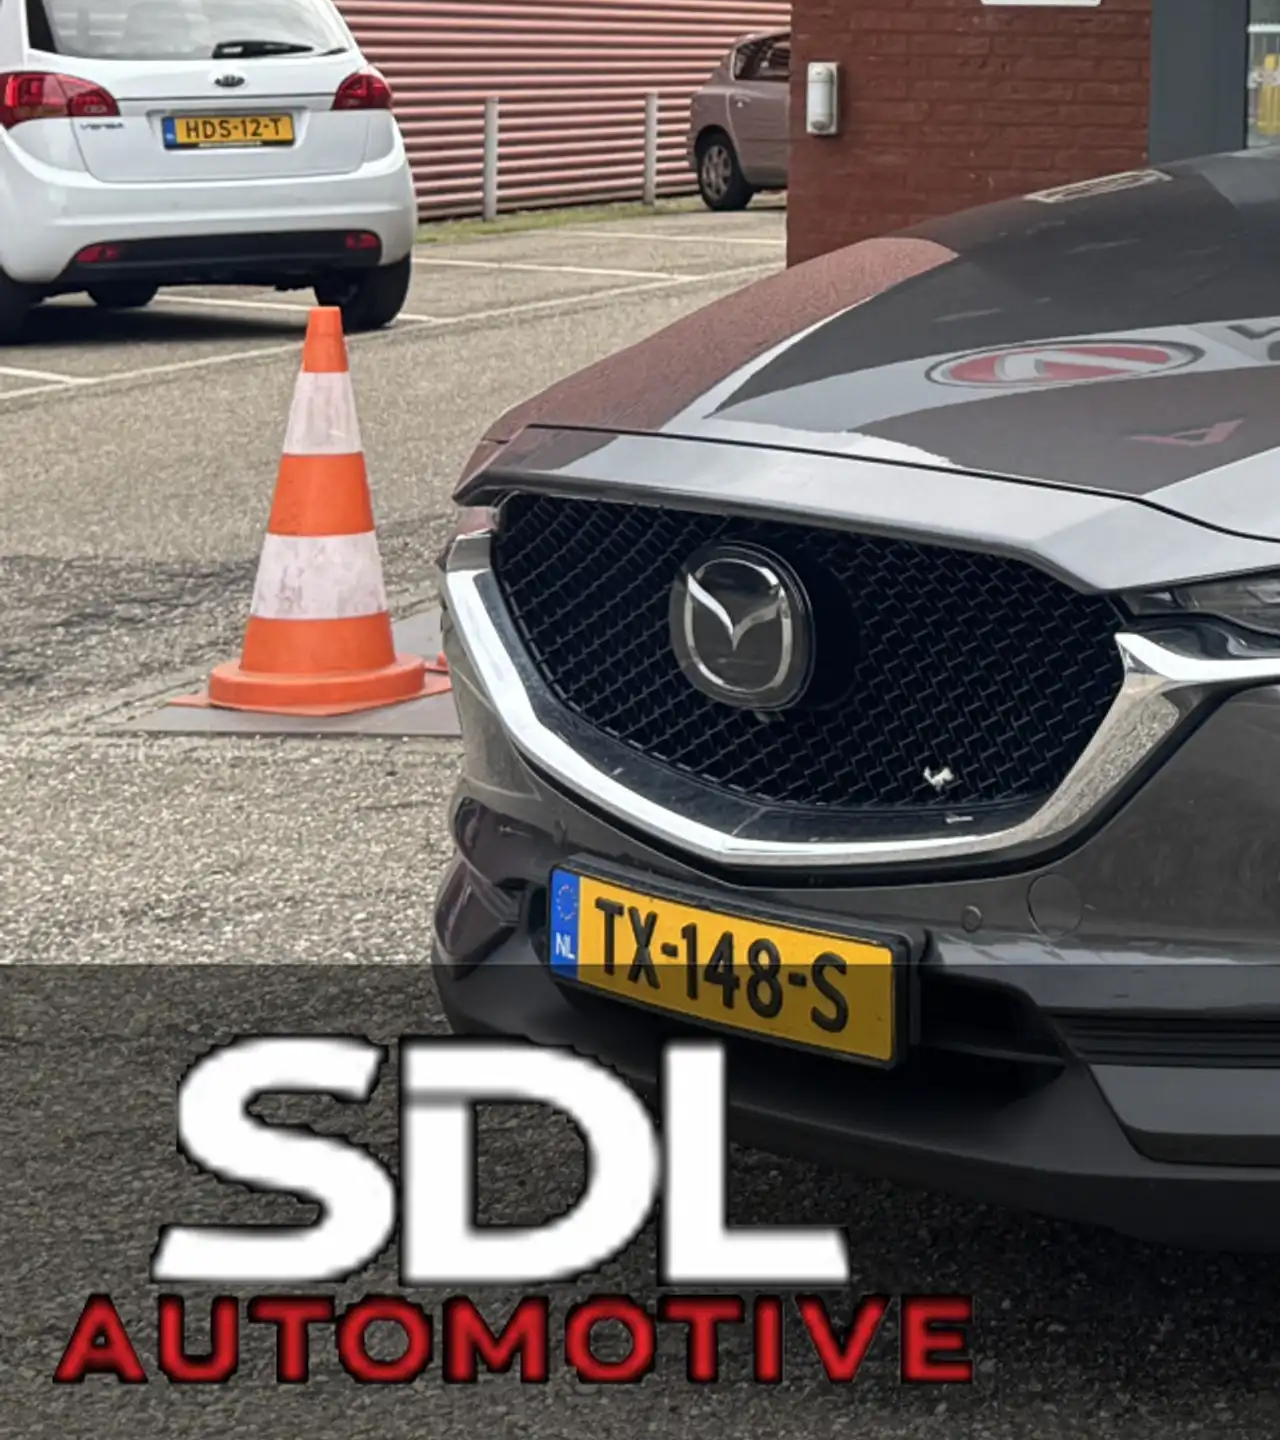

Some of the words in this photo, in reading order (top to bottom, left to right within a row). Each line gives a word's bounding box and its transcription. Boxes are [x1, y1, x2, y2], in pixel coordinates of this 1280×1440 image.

[185, 118, 282, 139] HDS-12-T
[555, 932, 576, 959] NL
[595, 897, 849, 1033] TX-148-S
